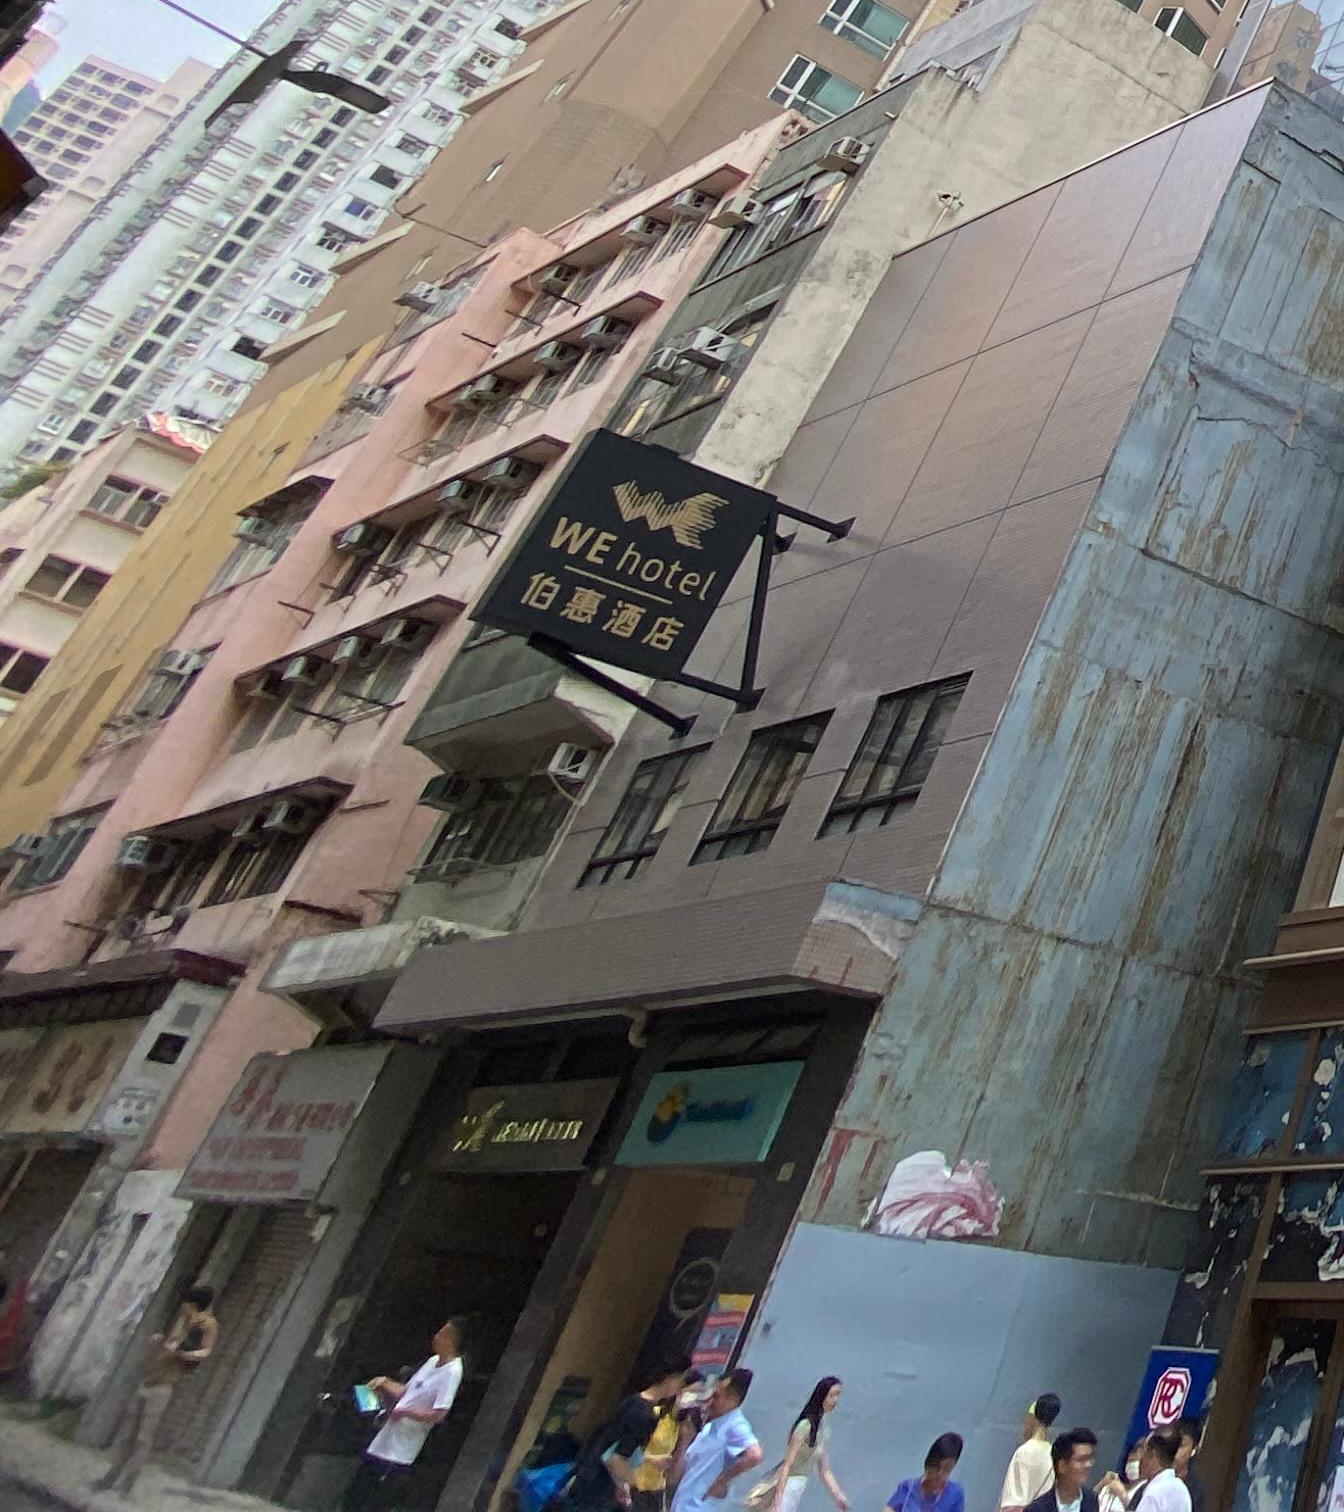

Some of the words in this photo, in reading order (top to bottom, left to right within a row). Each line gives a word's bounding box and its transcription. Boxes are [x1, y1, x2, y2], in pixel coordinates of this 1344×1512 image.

[550, 516, 618, 565] WE
[615, 542, 717, 601] hotel
[520, 571, 685, 651] 伯惠酒店
